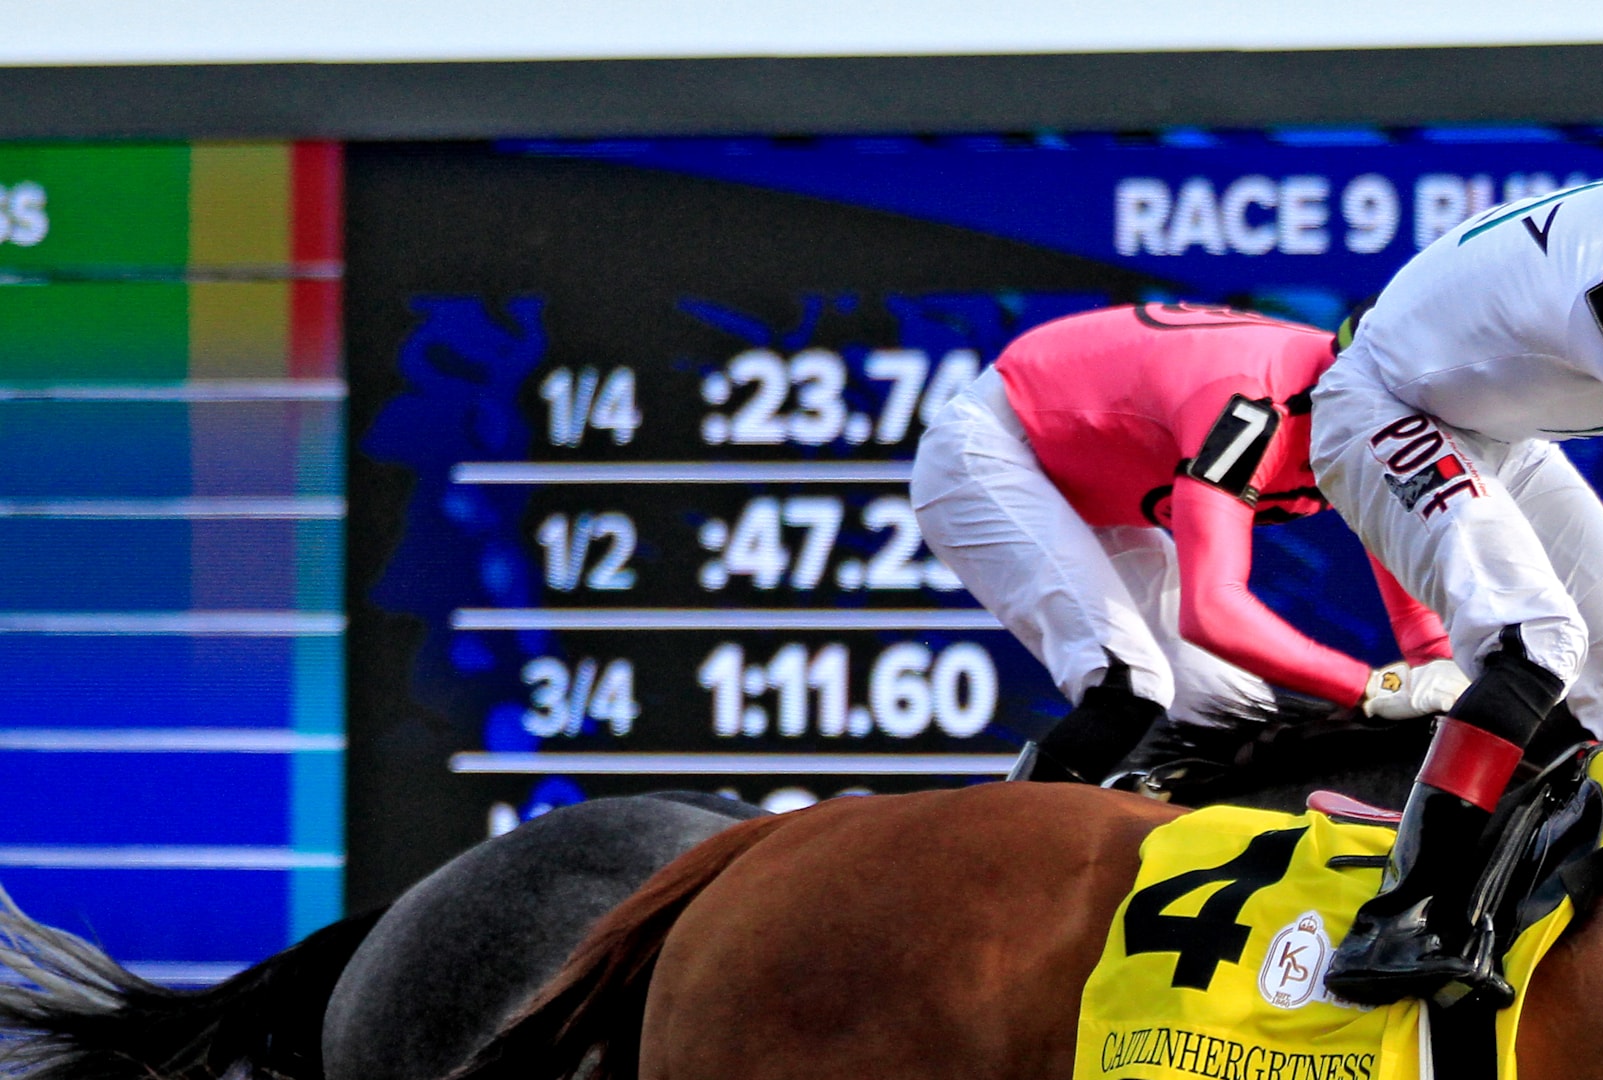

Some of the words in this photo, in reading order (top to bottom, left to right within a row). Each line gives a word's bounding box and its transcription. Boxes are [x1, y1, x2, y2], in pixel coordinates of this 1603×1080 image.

[1114, 174, 1330, 255] RACE
[1343, 174, 1400, 254] 9
[540, 367, 641, 446] 1/4
[1203, 403, 1269, 483] 7
[537, 513, 638, 591] 1/2
[521, 657, 640, 736] 3/4
[699, 643, 998, 738] 1:11.60
[1124, 824, 1309, 991] 4
